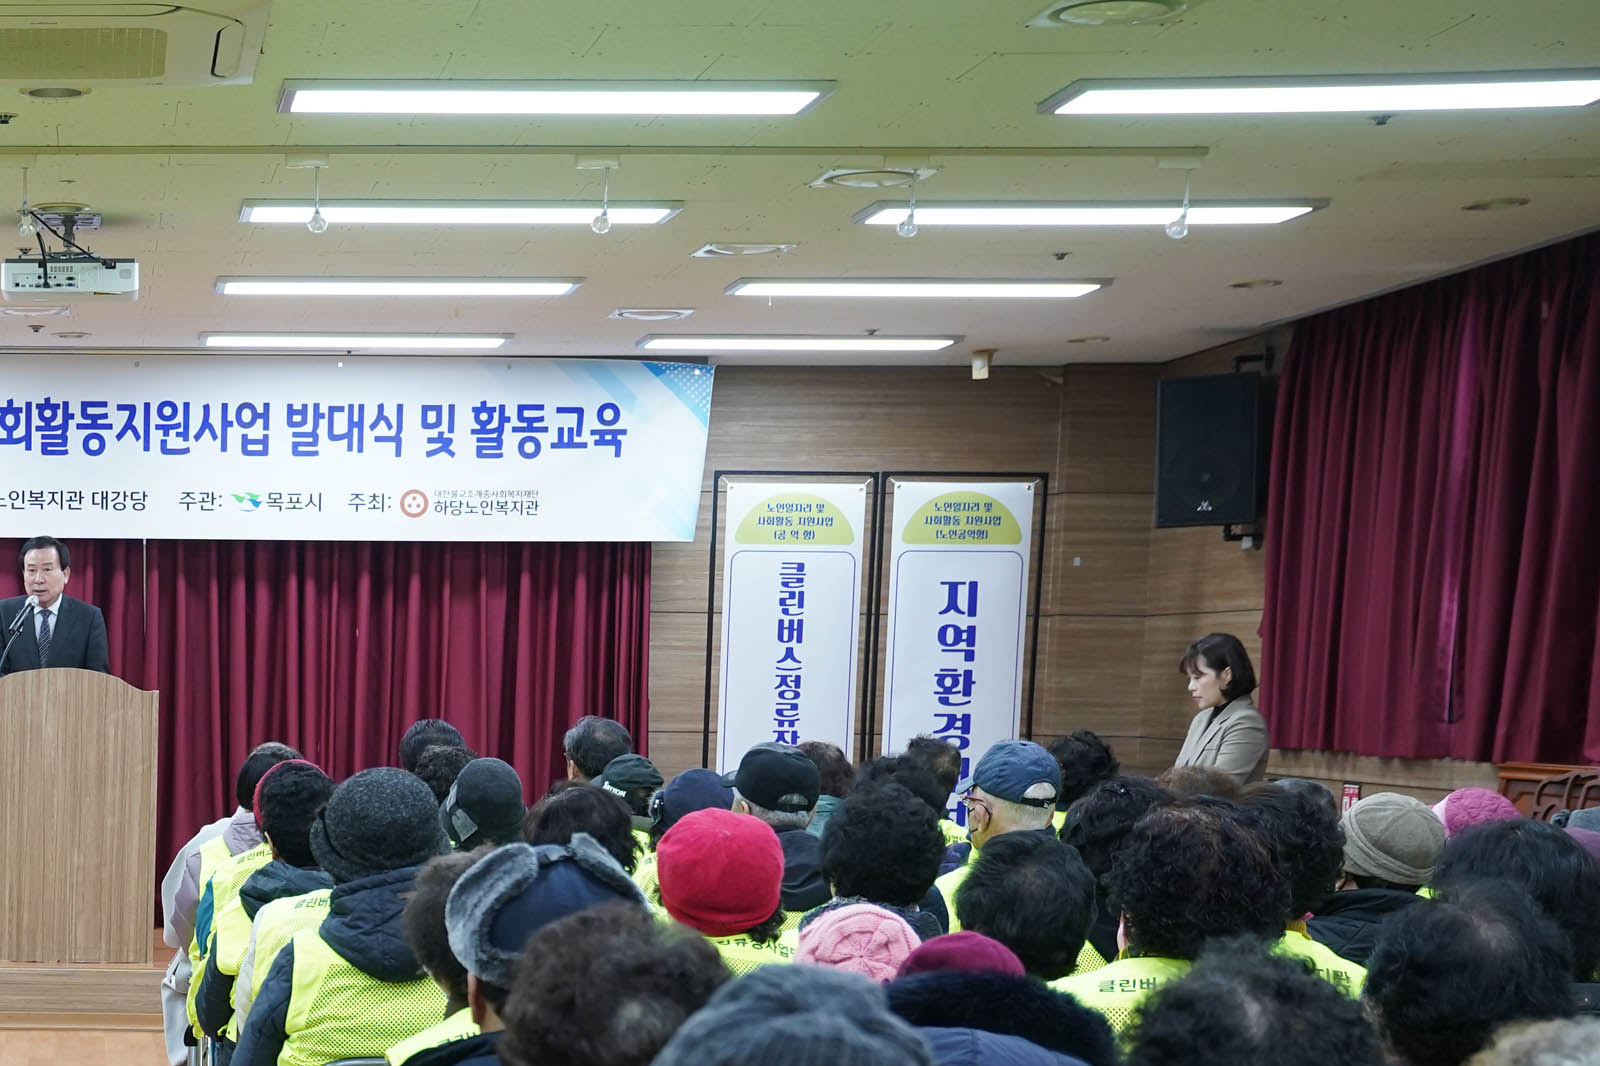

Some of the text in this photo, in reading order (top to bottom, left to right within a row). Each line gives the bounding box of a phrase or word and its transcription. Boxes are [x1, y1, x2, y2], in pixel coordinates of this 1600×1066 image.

[286, 401, 404, 458] 발대식
[420, 402, 456, 459] 및
[470, 400, 628, 460] 활동교육
[91, 490, 149, 512] 대강당
[178, 491, 223, 512] 주관:
[265, 492, 322, 513] 목포시
[347, 492, 392, 513] 주최:
[434, 499, 540, 517] 하당노인복지관
[767, 503, 812, 513] 노인일자리
[934, 502, 980, 513] 노인일자리
[756, 516, 834, 527] 사회활동 지원사업
[924, 515, 1002, 526] 사회활동 지원사업
